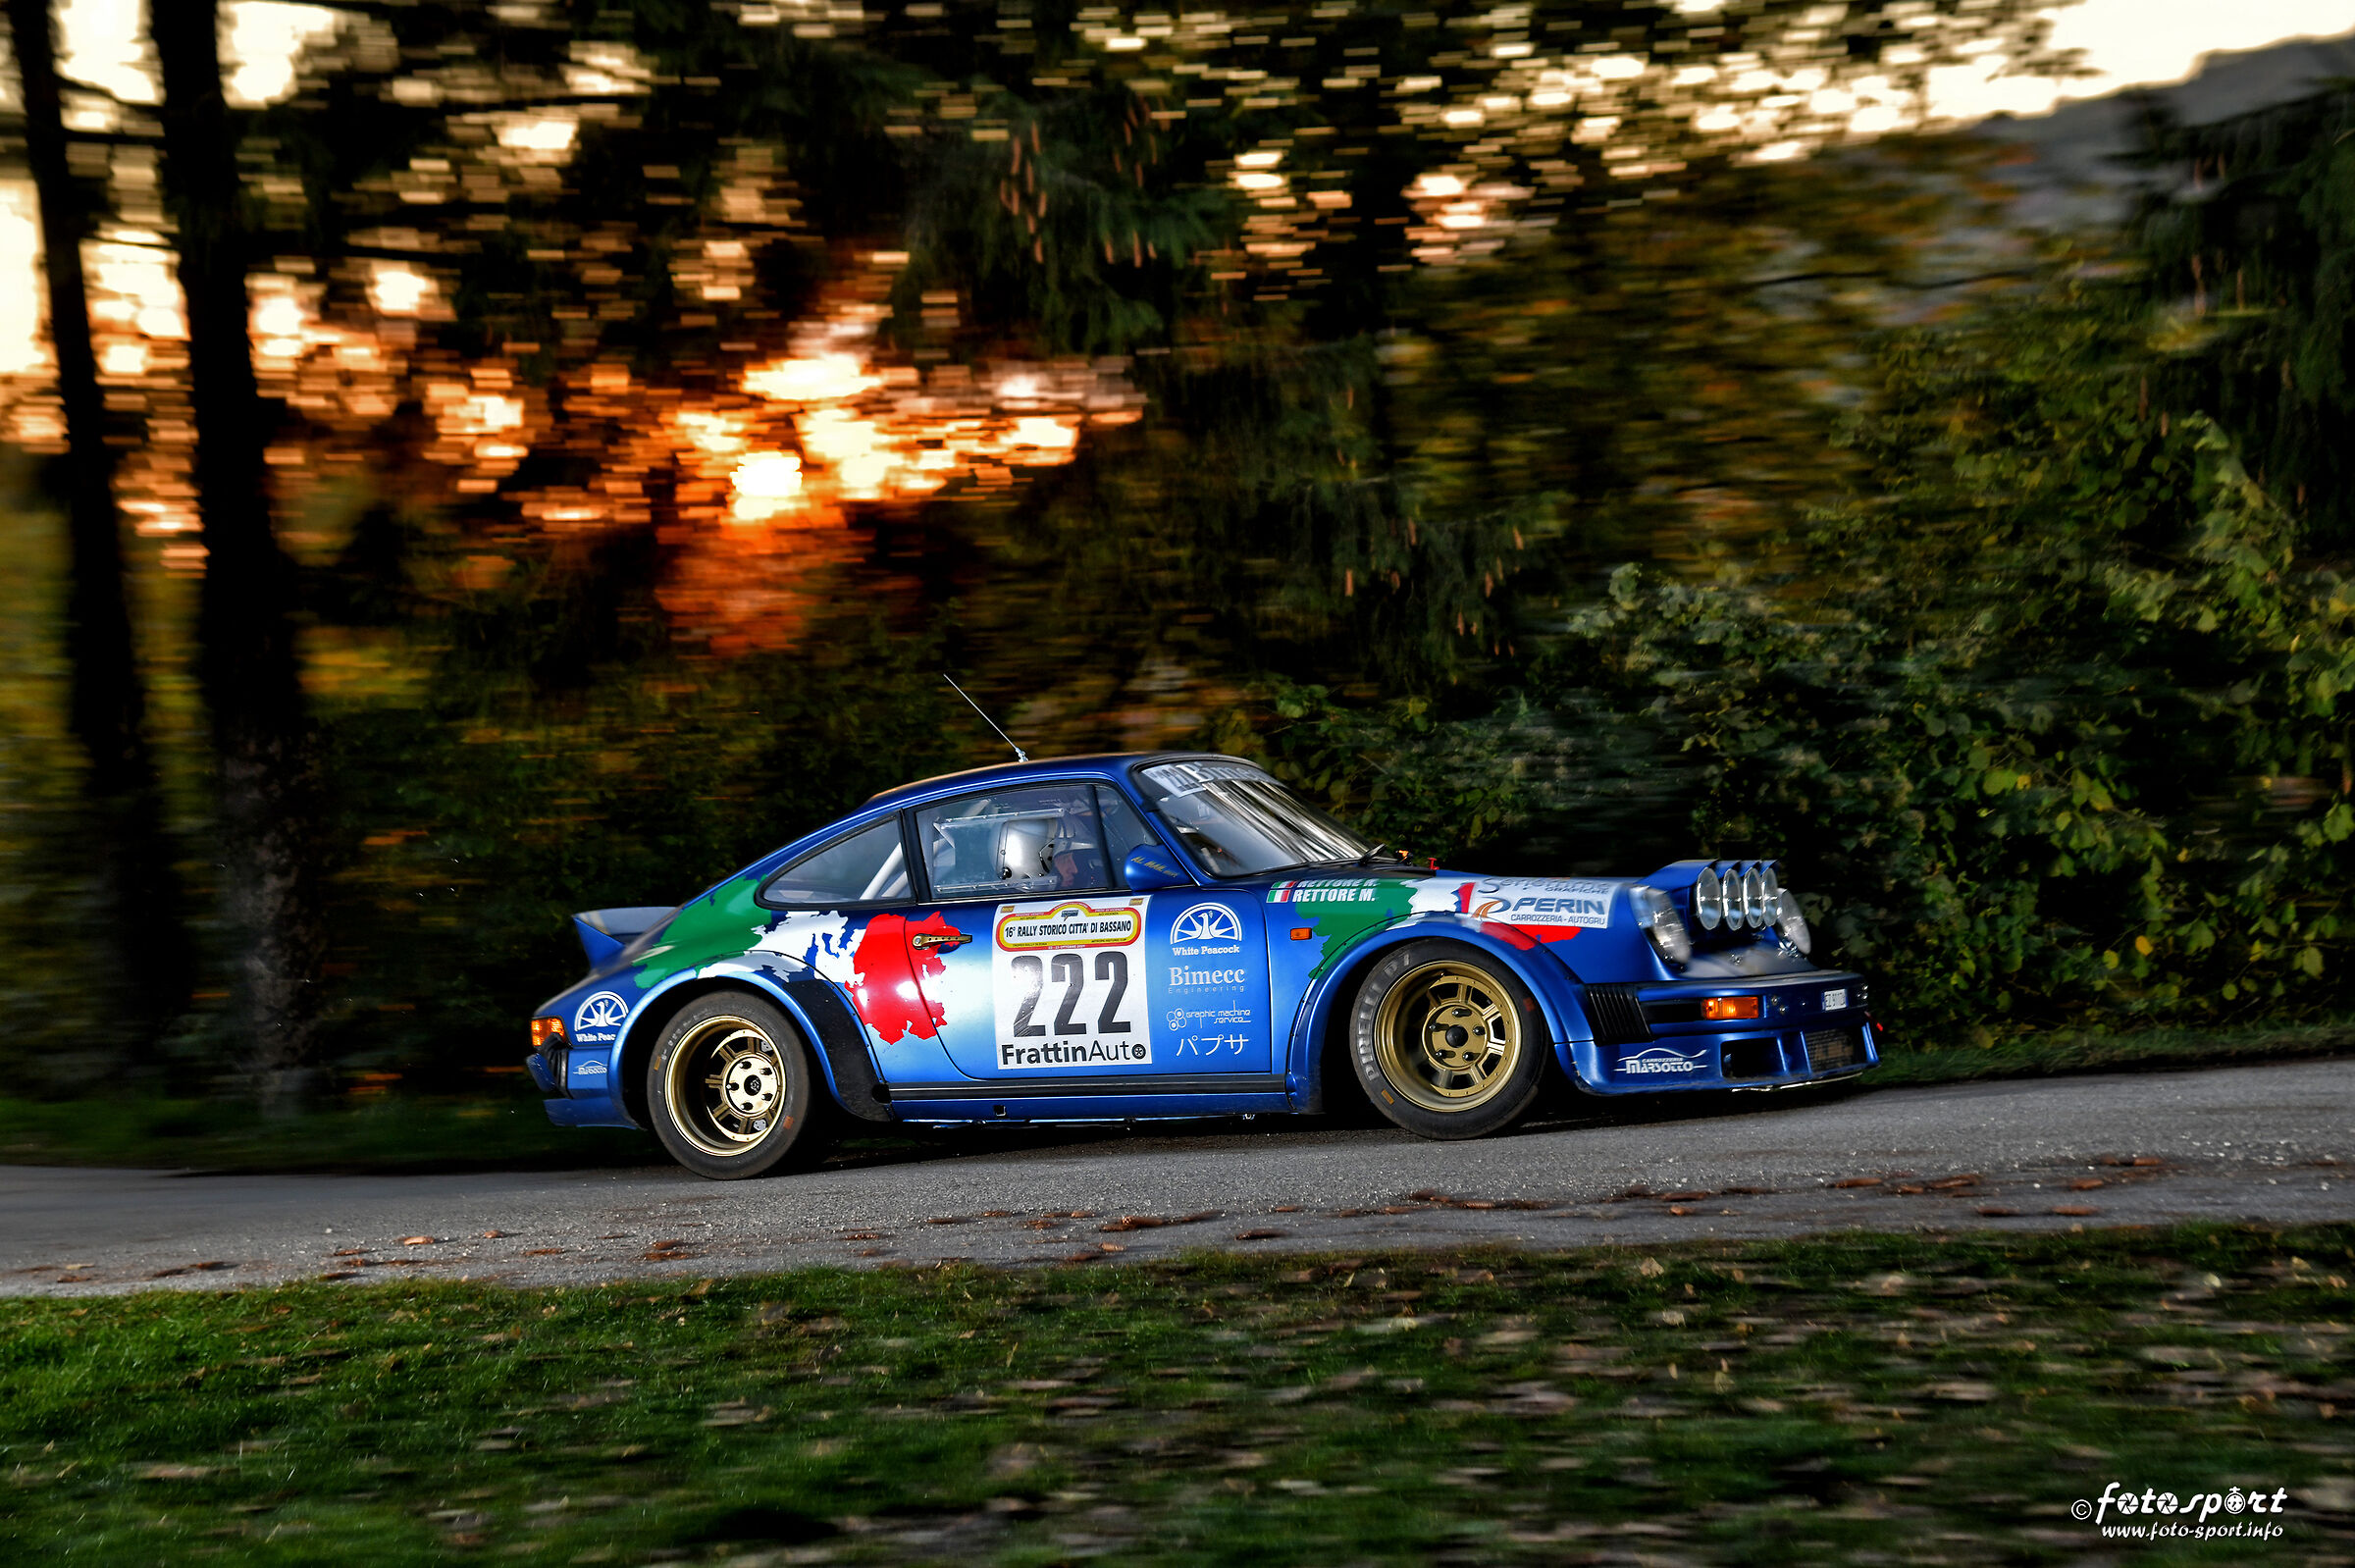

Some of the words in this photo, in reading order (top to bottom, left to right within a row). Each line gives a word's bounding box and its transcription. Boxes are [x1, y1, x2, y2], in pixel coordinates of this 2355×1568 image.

[1291, 888, 1358, 903] RETTORE
[1358, 888, 1376, 902] M.
[1512, 897, 1605, 915] PERIN
[1510, 914, 1563, 923] CARROZZERIA
[1567, 916, 1605, 925] AUTOGRU
[1018, 925, 1038, 937] RALLY
[1038, 923, 1067, 936] STORICO
[1069, 922, 1089, 935] CITTA'
[1090, 922, 1098, 933] DI
[1099, 919, 1131, 933] BASSANO
[1172, 947, 1199, 956] White
[1201, 945, 1240, 955] Peacock
[1169, 965, 1245, 986] Bimecc
[1011, 951, 1131, 1037] 222
[1168, 985, 1244, 994] Engineering
[575, 1033, 597, 1042] White
[598, 1032, 616, 1041] Peac
[1176, 1033, 1249, 1056] パプサ
